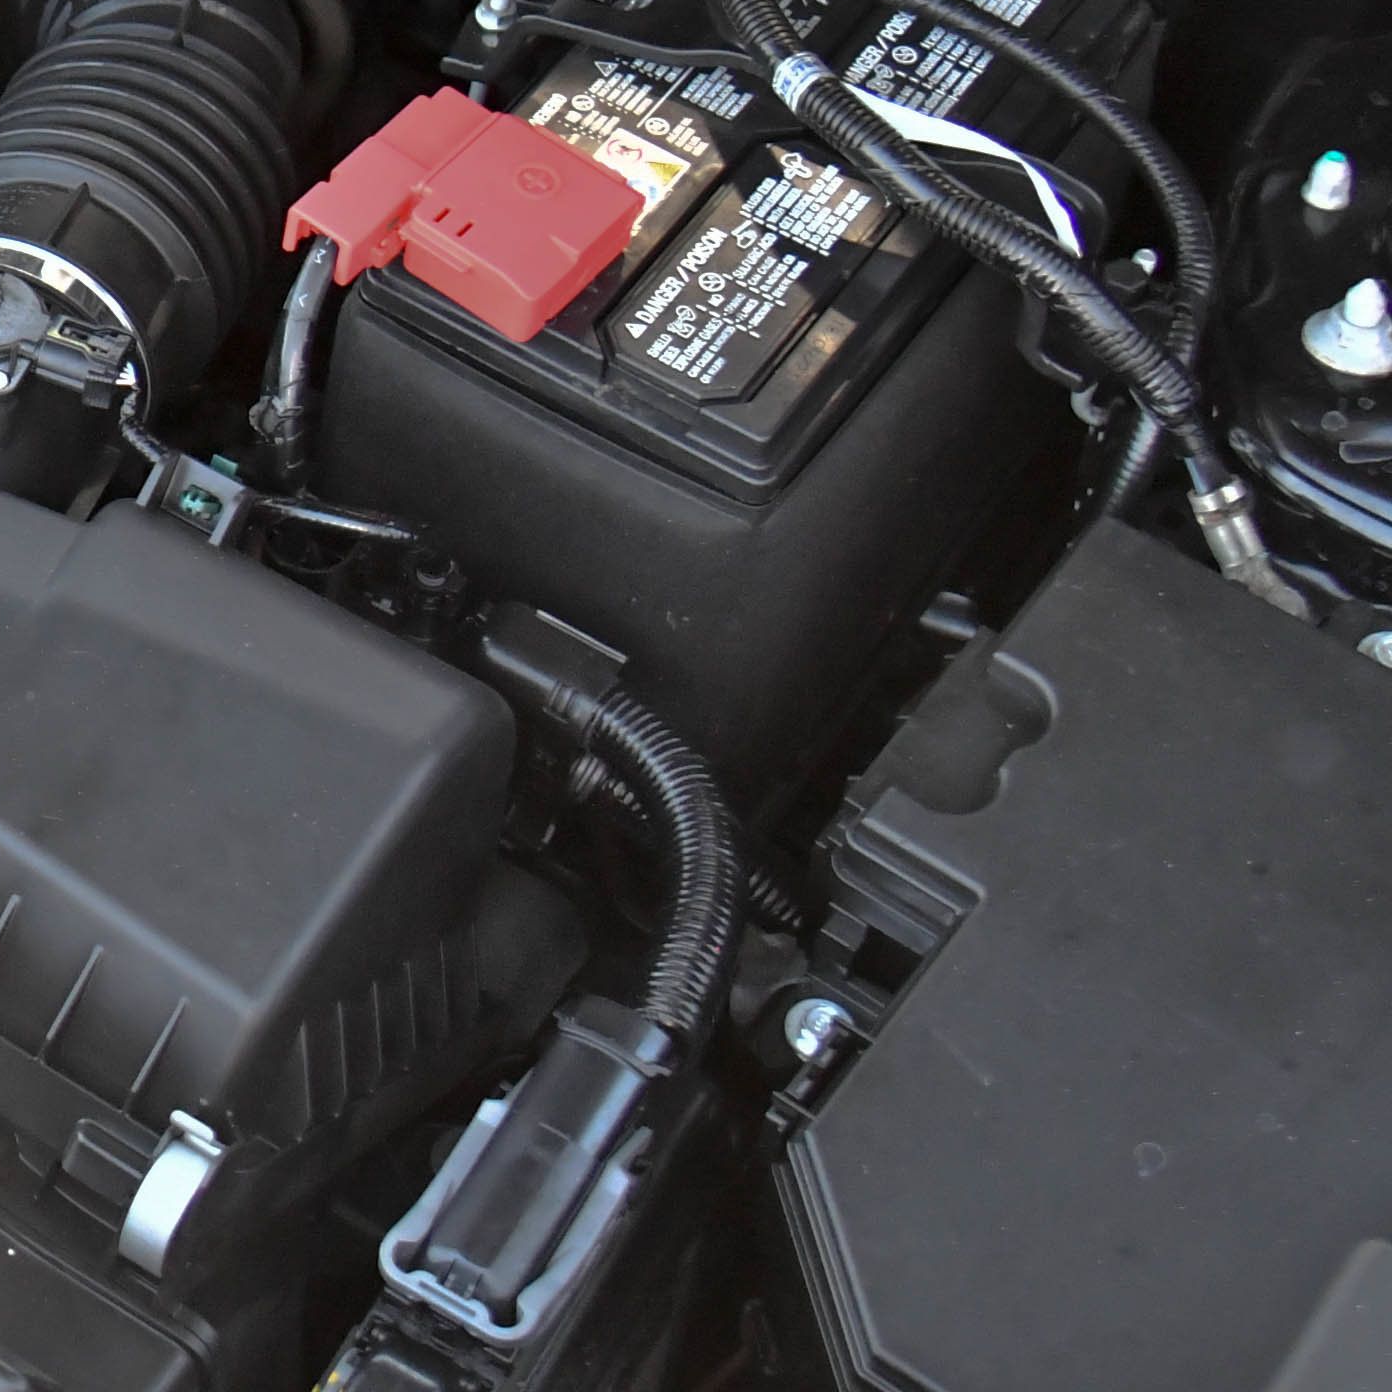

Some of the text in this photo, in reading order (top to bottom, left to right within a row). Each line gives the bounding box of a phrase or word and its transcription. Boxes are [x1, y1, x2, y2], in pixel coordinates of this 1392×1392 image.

[841, 43, 885, 85] ANGER
[634, 274, 685, 324] DANGER
[679, 225, 728, 272] POISON
